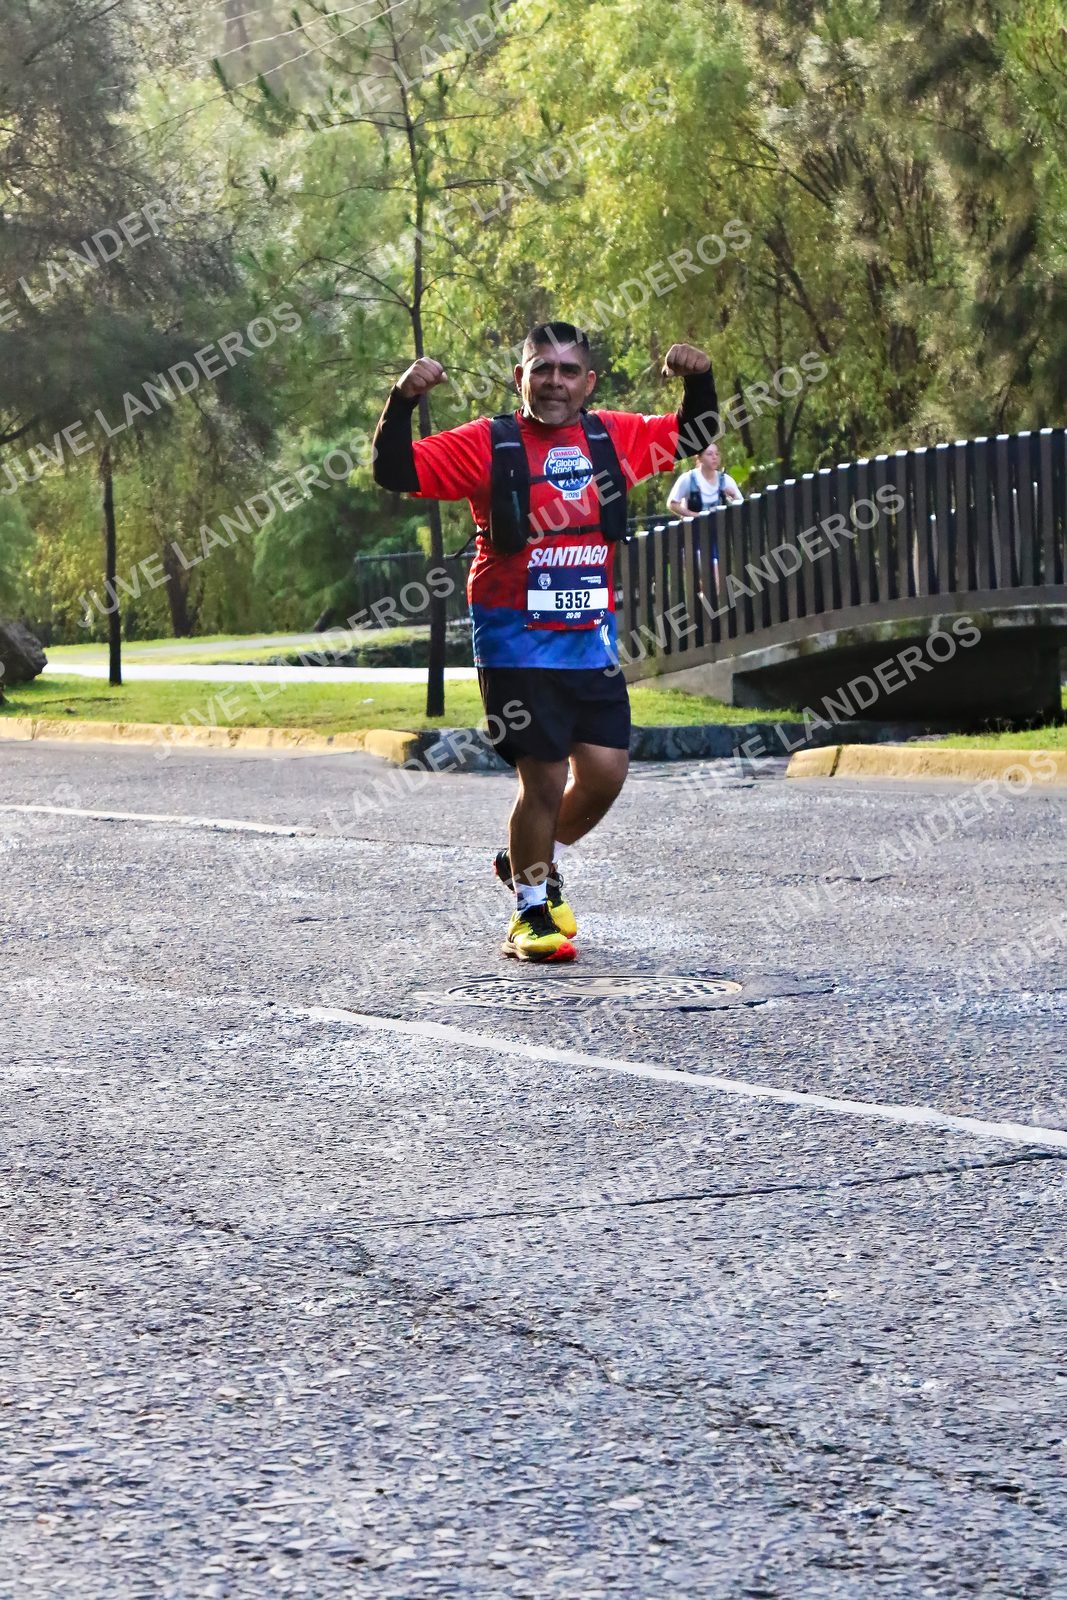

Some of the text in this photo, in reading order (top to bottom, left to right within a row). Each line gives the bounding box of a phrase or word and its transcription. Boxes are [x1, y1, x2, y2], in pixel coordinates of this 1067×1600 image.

[555, 458, 580, 467] Global
[528, 545, 608, 567] SANTIAGO
[555, 591, 591, 610] 5352
